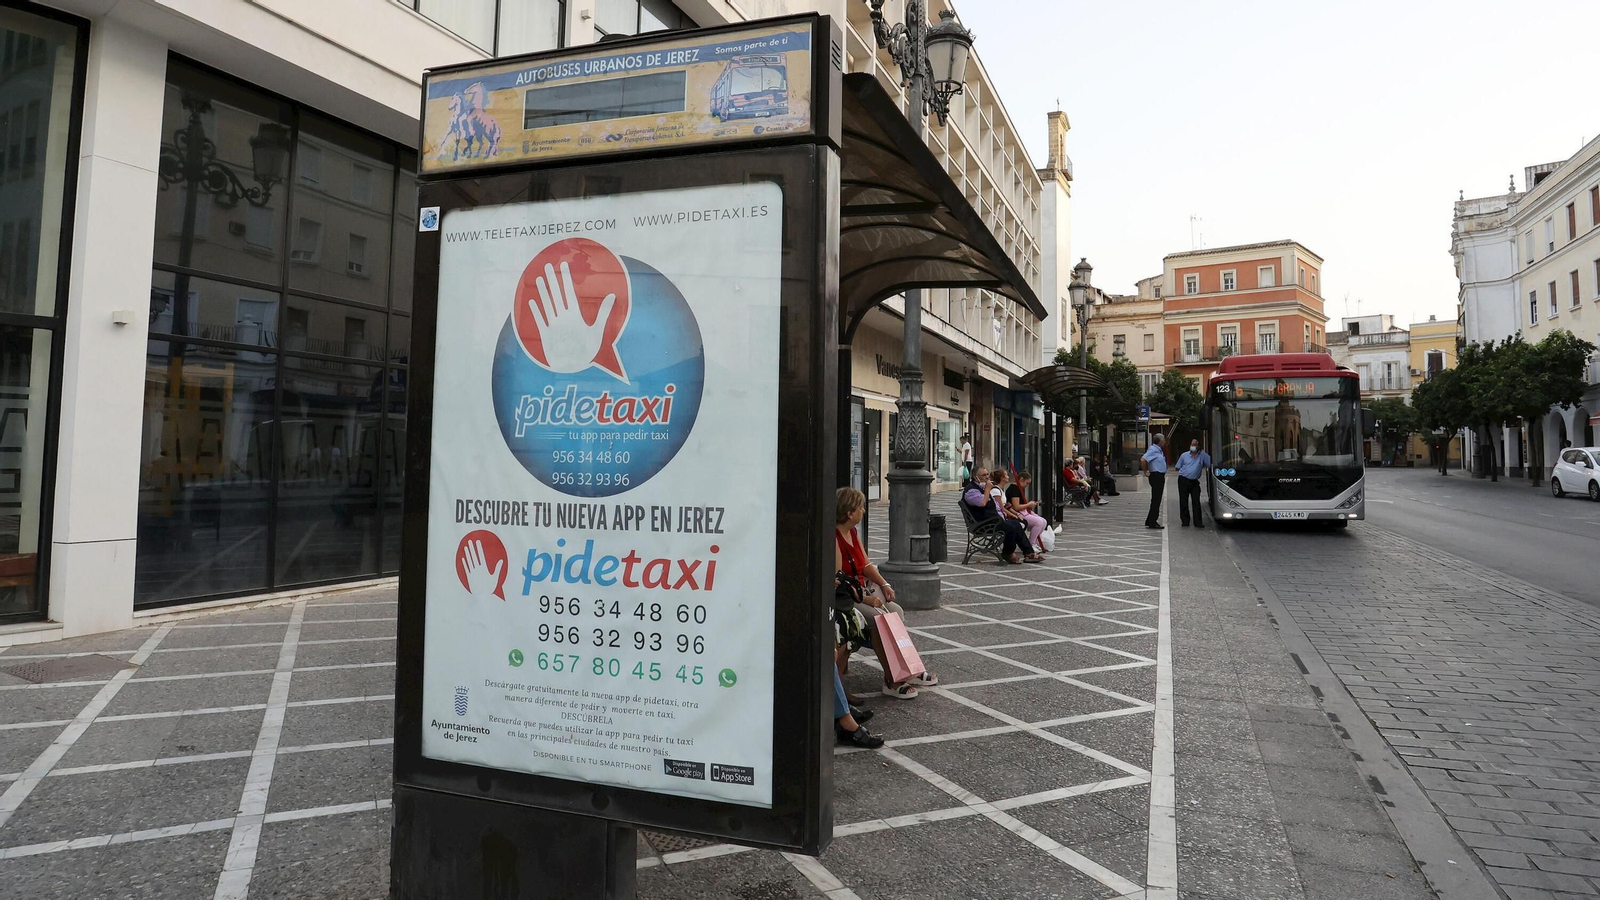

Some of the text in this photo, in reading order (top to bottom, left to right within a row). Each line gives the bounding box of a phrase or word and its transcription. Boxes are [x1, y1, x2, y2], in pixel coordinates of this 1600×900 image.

[715, 36, 789, 55] Somos parte de ti
[515, 49, 700, 86] AUTOBUSES URBANOS DE JEREZ
[532, 138, 571, 147] Ayuntamiento
[445, 205, 769, 243] WWW.TELETAXIJEREZ.COM WWW.PIDETAXI.ES
[1216, 385, 1230, 393] 123
[1236, 382, 1315, 397] 6 LA GRANJA
[515, 383, 677, 438] pidetaxi
[569, 430, 669, 442] tu app para pedir taxi
[552, 450, 631, 464] 956 34 48 60
[552, 472, 630, 486] 956 32 93 96
[455, 499, 725, 534] DESCUBRE TU NUEVA APP EN JEREZ
[522, 538, 720, 596] pidetaxi
[539, 595, 707, 624] 956 34 48 60
[538, 623, 705, 655] 956 32 93 96
[537, 652, 704, 685] 657 80 45 45
[484, 679, 525, 691] Descárgate
[527, 684, 579, 697] gratuitamente
[582, 689, 589, 697] la
[591, 691, 613, 700] nueva
[615, 695, 631, 704] app
[632, 695, 642, 703] de
[681, 700, 699, 709] otra
[504, 694, 533, 704] manera
[534, 696, 568, 708] diferente
[569, 700, 579, 709] de
[580, 703, 600, 712] pedir
[602, 704, 608, 713] y
[611, 706, 643, 716] moverte
[657, 710, 676, 720] taxi.
[431, 719, 490, 736] Ayuntamiento
[561, 711, 614, 725] DESCÚBRELA
[443, 730, 478, 743] de Jerez
[488, 714, 694, 746] Recuerda que puedes utilizar la app para pedir tu taxi
[518, 730, 528, 739] las
[530, 732, 573, 744] principales
[573, 737, 607, 749] ciudades
[609, 741, 618, 750] de
[620, 744, 651, 753] nuestro
[653, 747, 671, 757] país.
[533, 750, 652, 771] DISPONIBLE EN TU SMARTPHONE
[672, 766, 704, 779] Google play
[720, 772, 752, 783] App Store
